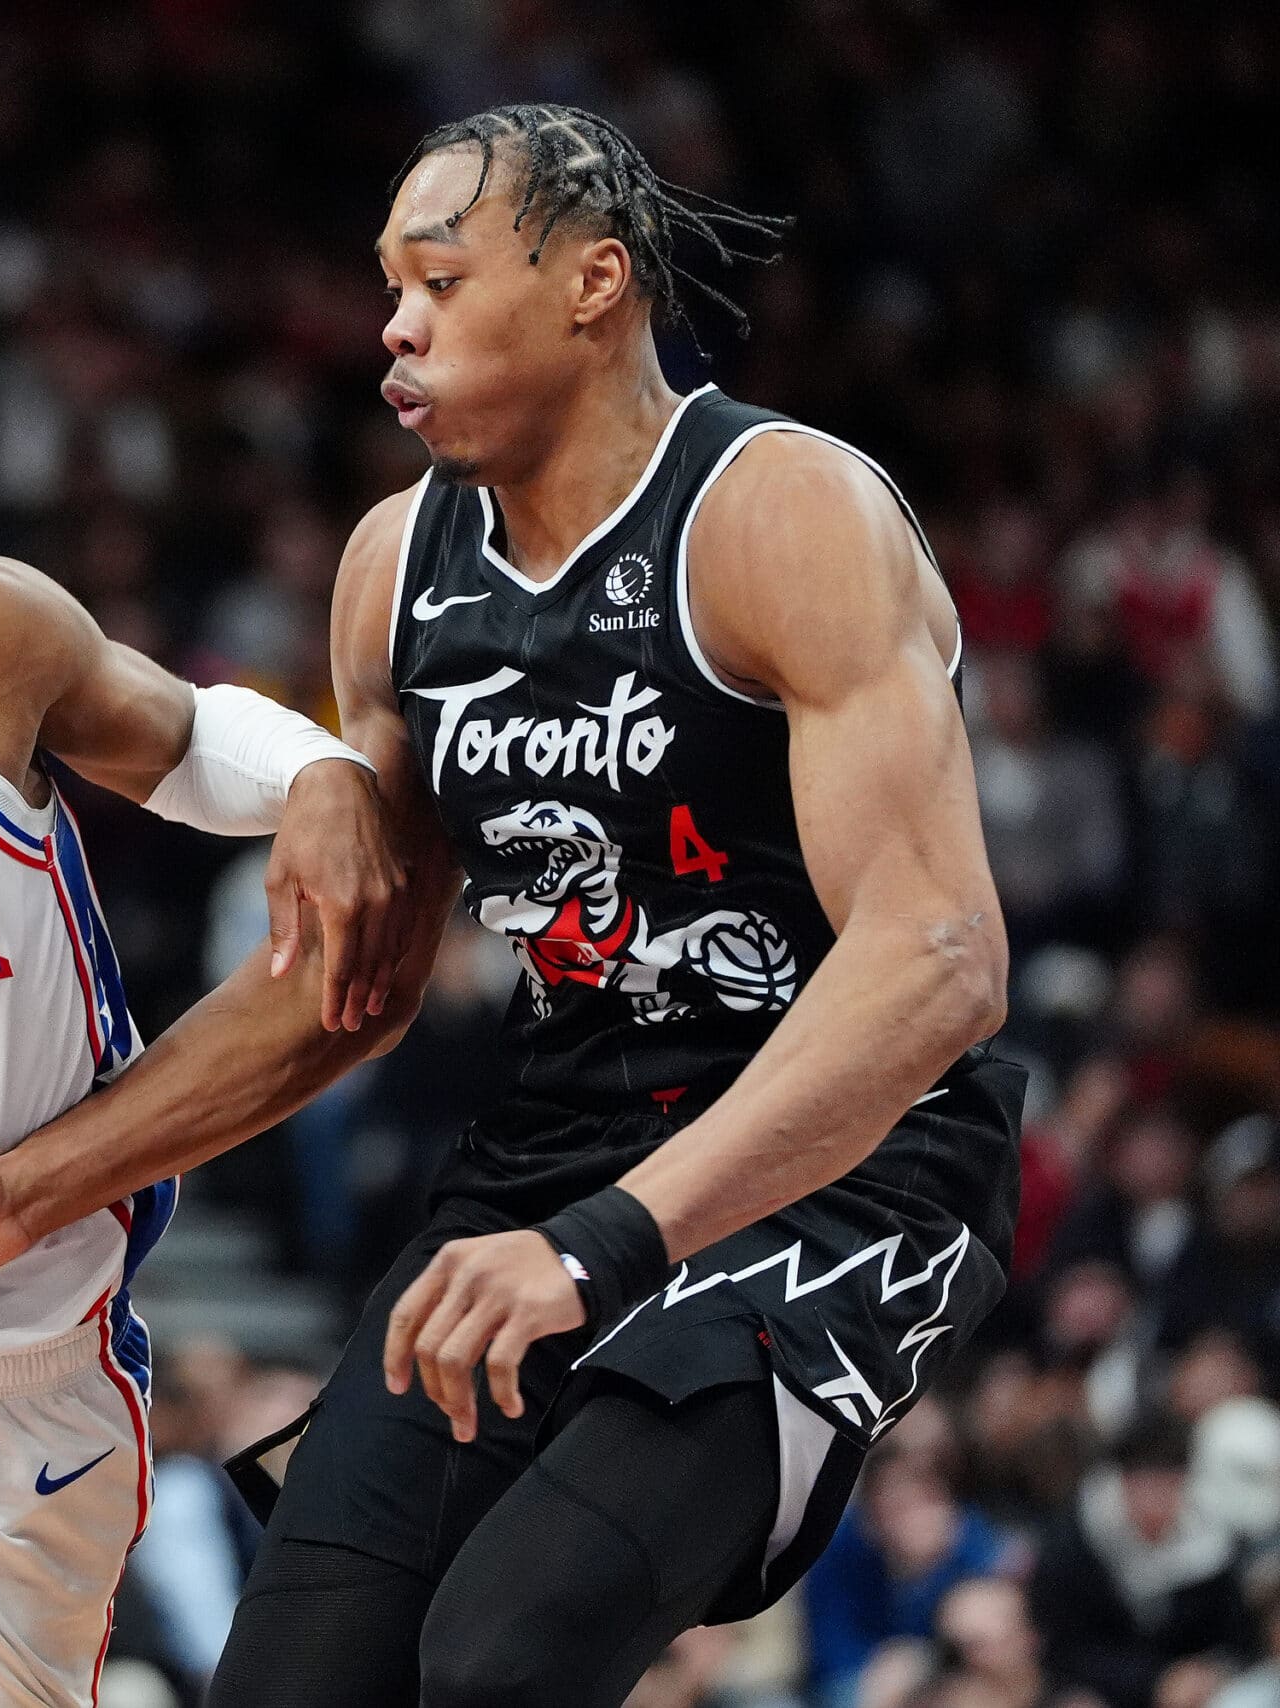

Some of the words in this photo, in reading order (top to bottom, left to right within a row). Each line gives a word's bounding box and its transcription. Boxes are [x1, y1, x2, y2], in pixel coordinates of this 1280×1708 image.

[589, 613, 624, 632] Sun
[628, 607, 660, 629] Life
[401, 666, 676, 795] Toronto
[669, 805, 729, 882] 4
